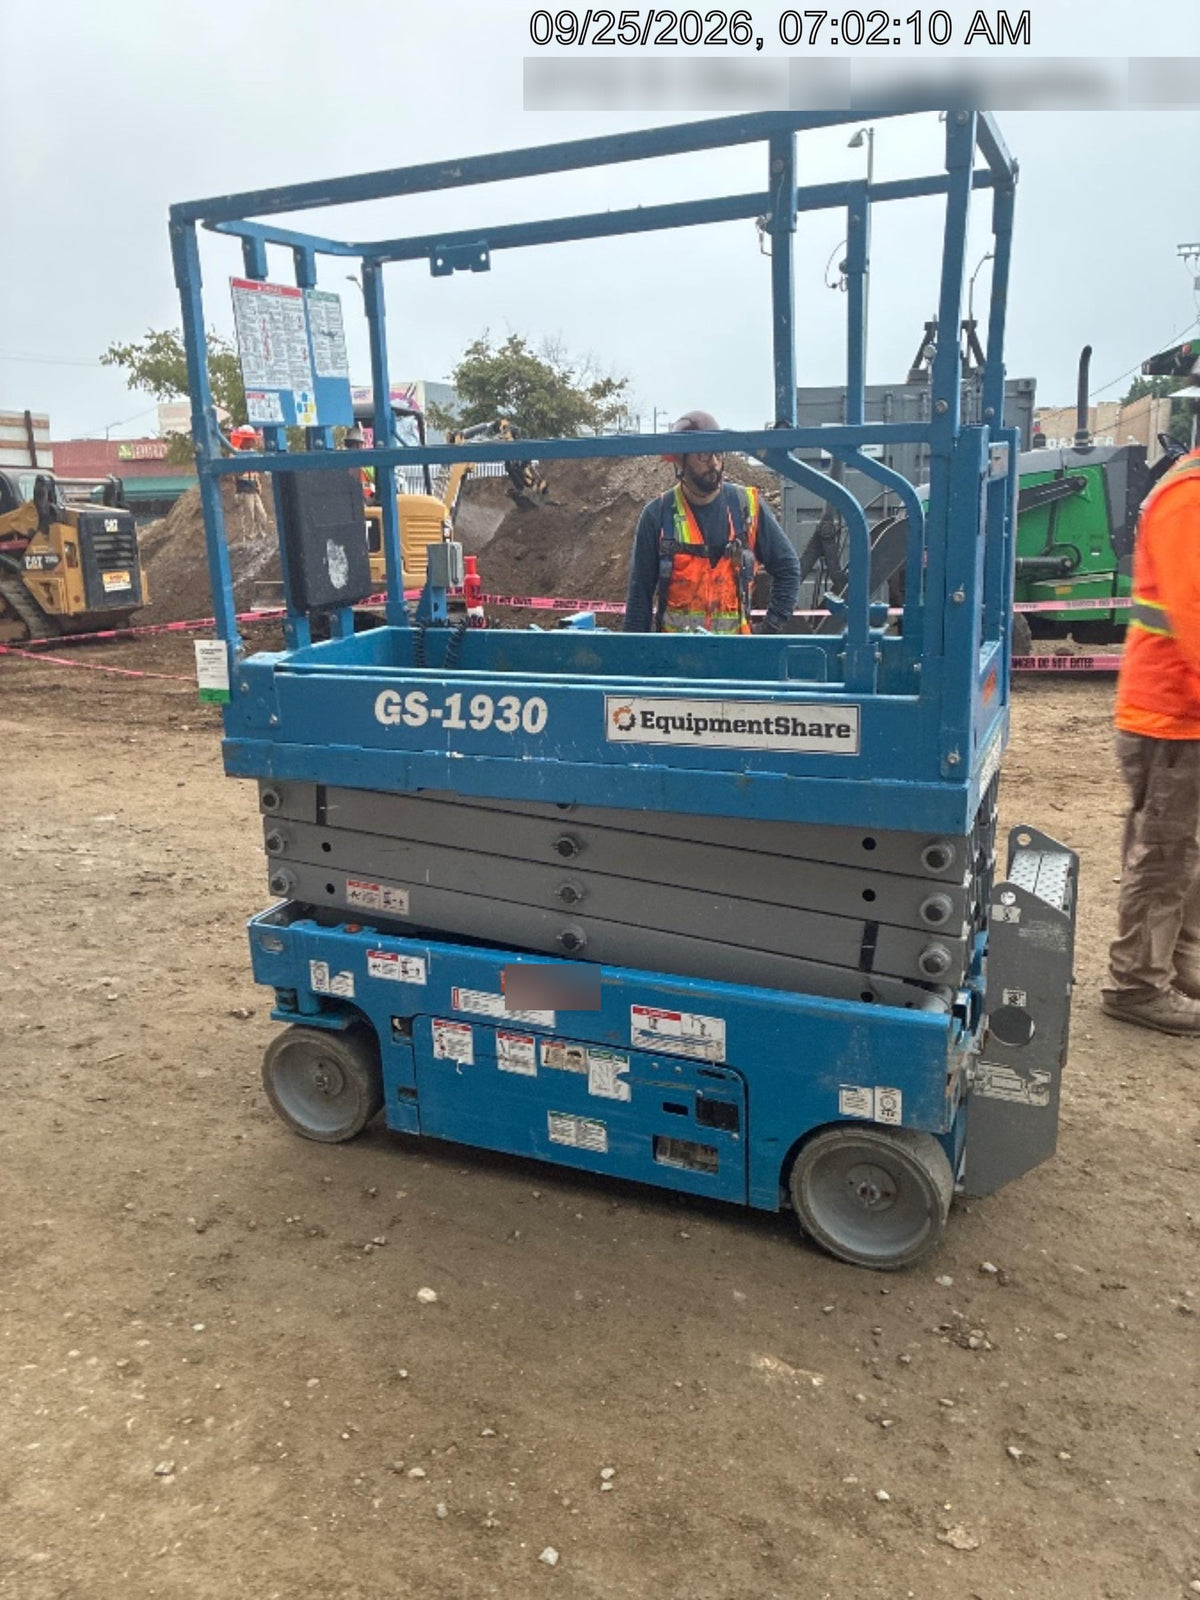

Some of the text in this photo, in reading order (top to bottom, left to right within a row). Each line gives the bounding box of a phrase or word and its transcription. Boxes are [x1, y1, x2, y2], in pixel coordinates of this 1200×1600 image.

[25, 556, 43, 569] CAT
[1038, 657, 1049, 669] DO
[1052, 657, 1068, 669] NOT
[1070, 657, 1095, 669] ENTER
[374, 689, 548, 735] GS-1930
[640, 710, 851, 739] EquipmentShare
